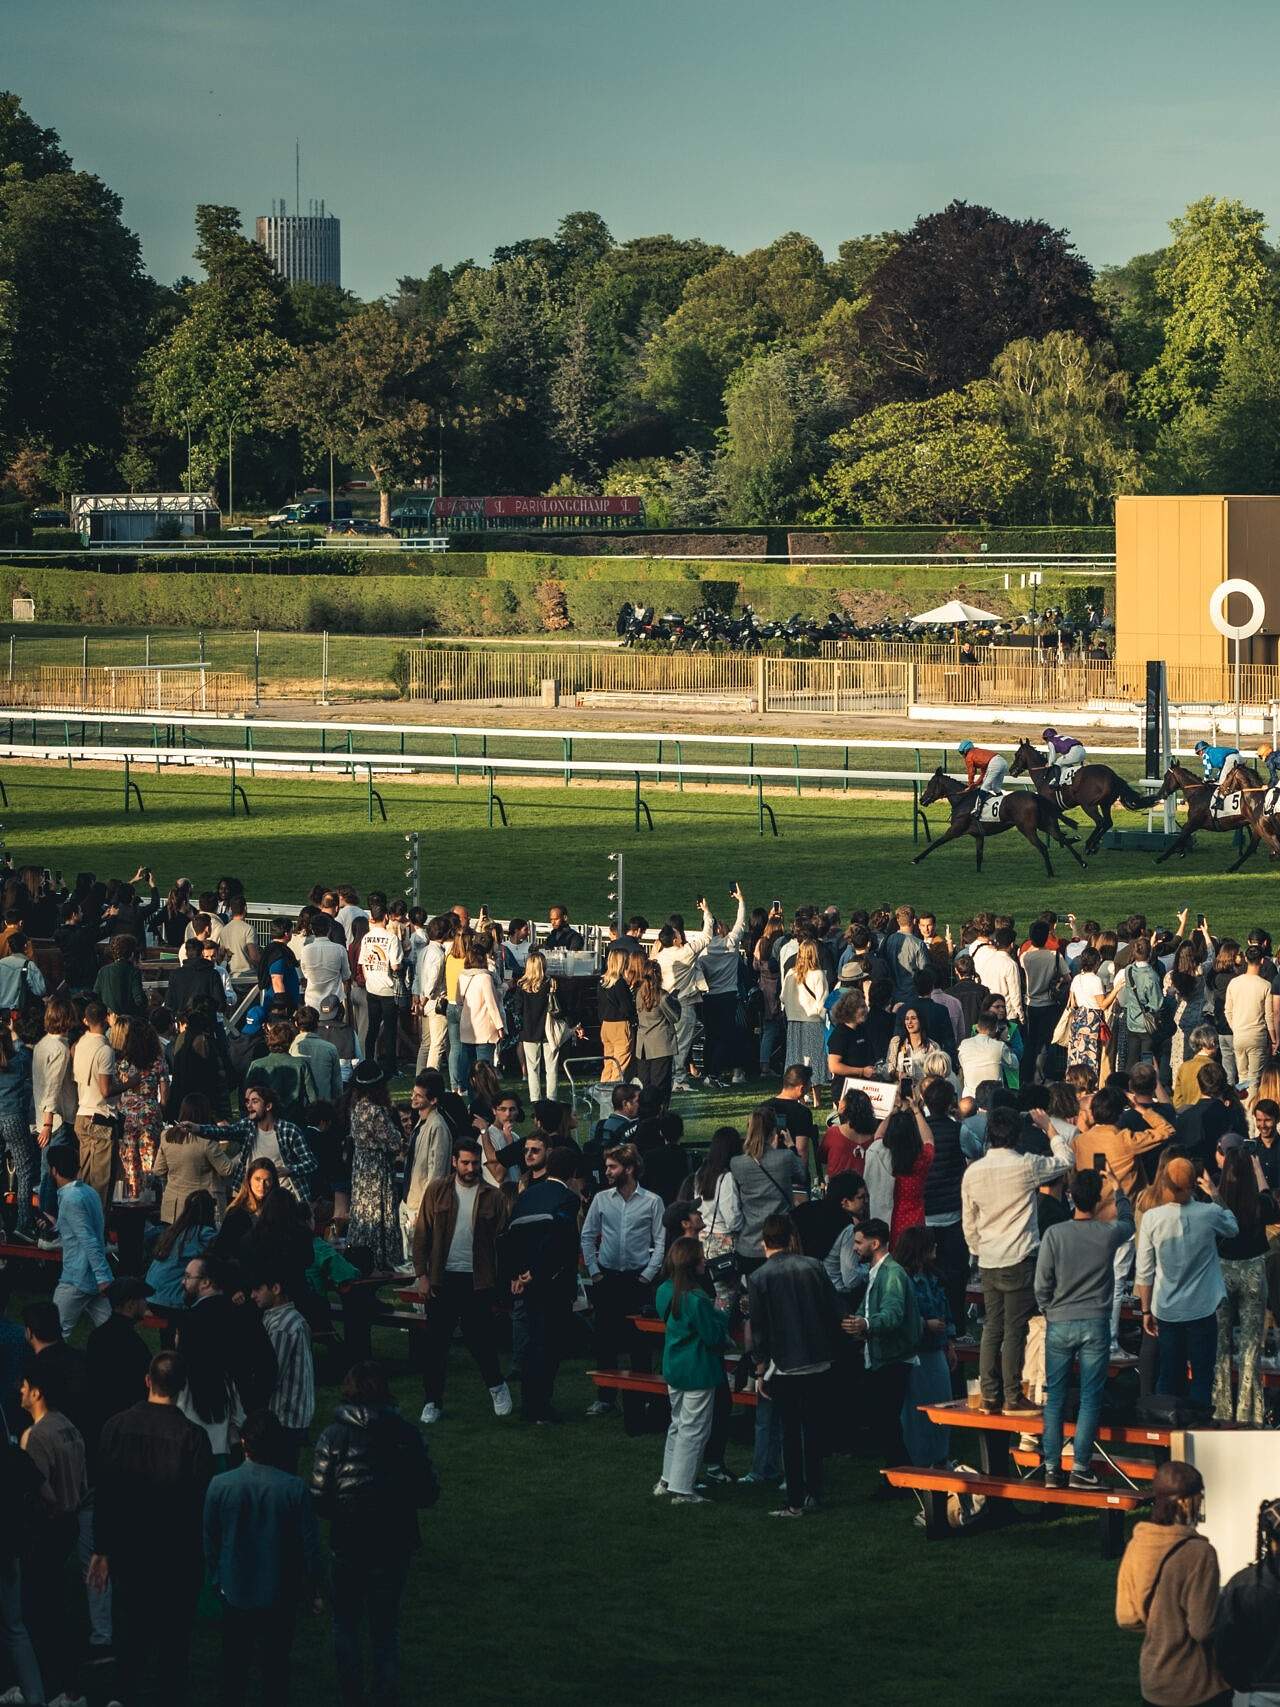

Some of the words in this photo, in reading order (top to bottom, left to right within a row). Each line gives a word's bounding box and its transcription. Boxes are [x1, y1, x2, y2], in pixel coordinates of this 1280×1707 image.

[515, 499, 610, 513] PARISLONGCHAMP
[991, 801, 999, 817] 6
[1232, 795, 1240, 810] 5
